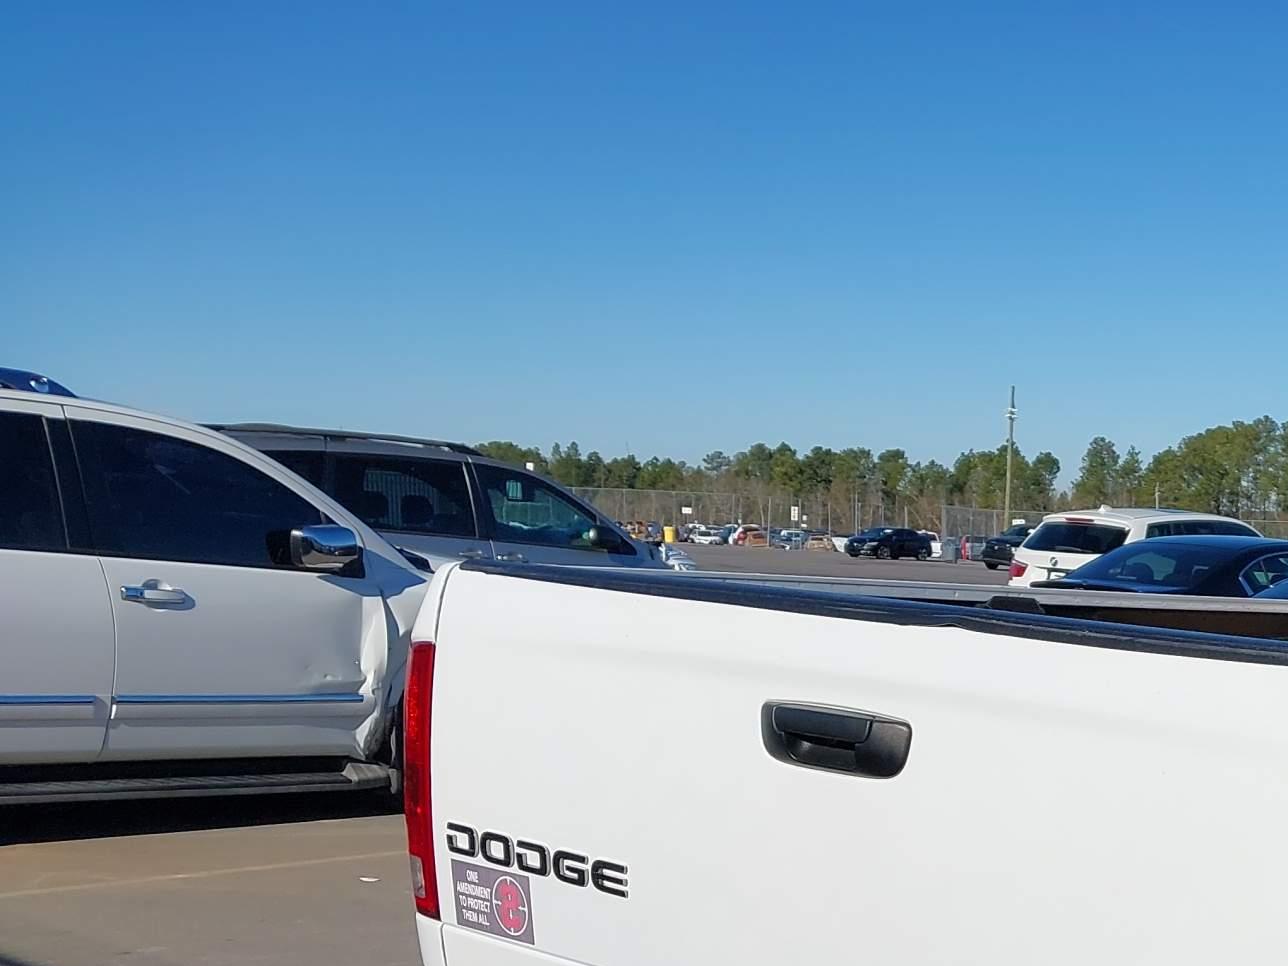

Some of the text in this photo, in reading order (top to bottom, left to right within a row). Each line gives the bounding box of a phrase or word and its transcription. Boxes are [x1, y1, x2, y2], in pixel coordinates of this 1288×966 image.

[446, 822, 629, 899] DODGE
[466, 869, 479, 883] ONE
[456, 880, 492, 900] AMENDMENT
[459, 895, 491, 913] TO PROTECT
[462, 908, 490, 926] THEM ALL
